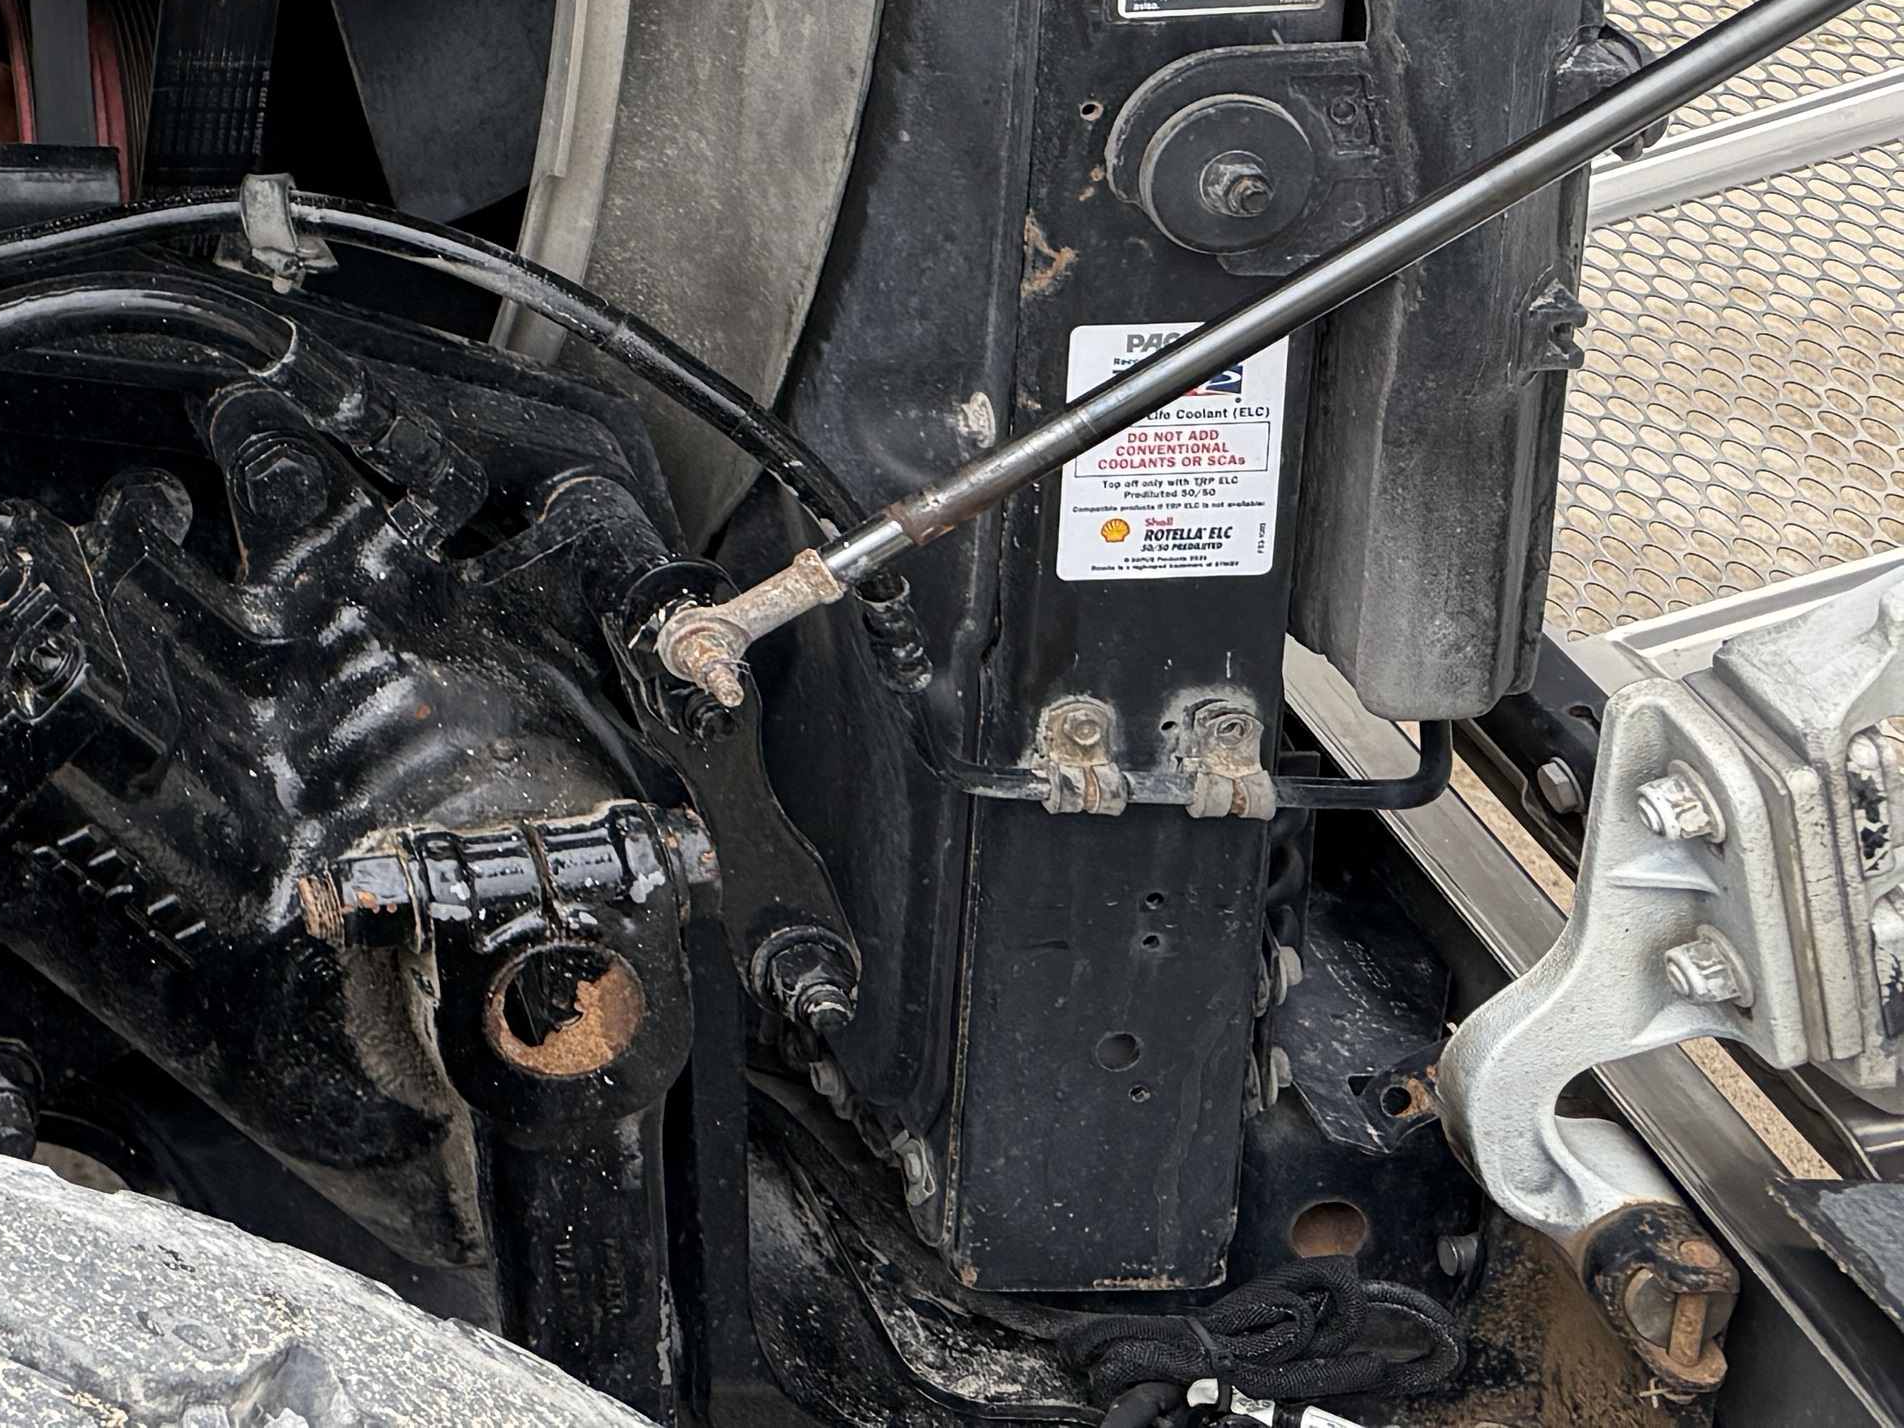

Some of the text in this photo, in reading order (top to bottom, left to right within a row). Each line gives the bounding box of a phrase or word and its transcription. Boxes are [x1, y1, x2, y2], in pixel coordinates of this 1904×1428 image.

[1176, 409, 1228, 419] Coolant
[1233, 407, 1270, 419] (ELC)
[1127, 429, 1219, 443] DO NOT ADD
[1116, 442, 1230, 457] CONVENTIONAL
[1098, 455, 1246, 471] COOLANTS OR SCAs
[1103, 476, 1239, 490] Top off only with TRP ELC
[1124, 488, 1216, 500] Prediluted 50/50
[1145, 517, 1173, 527] Shell
[1144, 526, 1233, 542] ROTELLA ELC
